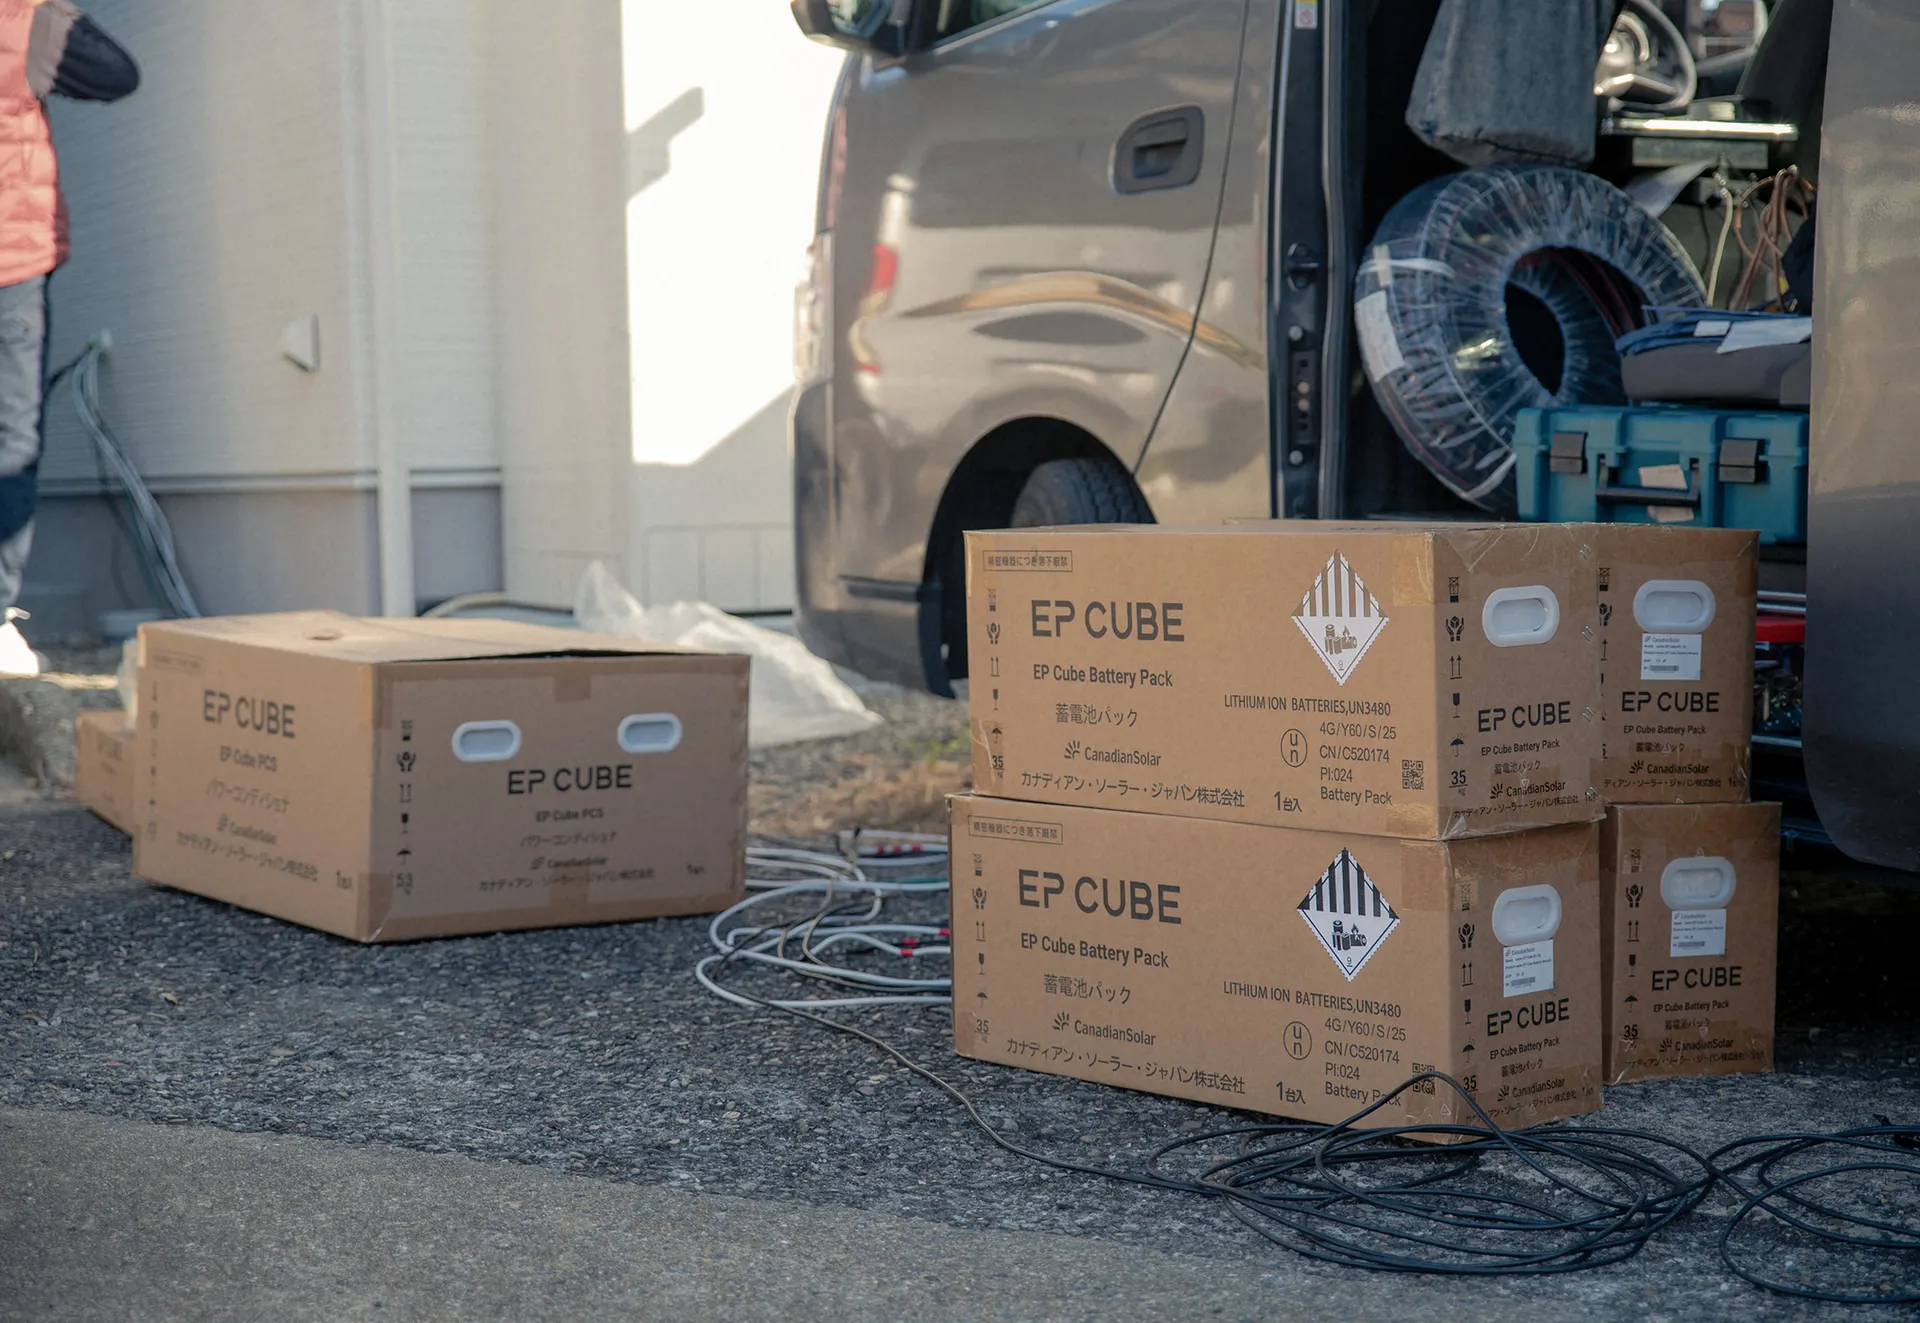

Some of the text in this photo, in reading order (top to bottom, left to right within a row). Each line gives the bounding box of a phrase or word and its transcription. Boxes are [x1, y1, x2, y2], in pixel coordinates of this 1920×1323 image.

[1031, 600, 1185, 642] EP CUBE
[1338, 660, 1344, 668] 9
[1034, 664, 1173, 689] EP Cube Battery Pack
[1224, 694, 1265, 709] LITHIUM
[1268, 697, 1287, 710] ION
[1621, 691, 1720, 712] EP CUBE
[203, 689, 296, 738] EP CUBE
[1056, 703, 1138, 727] 蓄電池パック
[1478, 701, 1571, 732] EP CUBE
[1624, 725, 1706, 736] EP Cube Battery Pack
[1085, 747, 1161, 766] CanadianSolar
[1320, 745, 1389, 762] CN/C520174
[1481, 739, 1560, 756] EP Cube Battery Pack
[220, 745, 278, 772] EP Cube PCS
[992, 755, 1003, 768] 35
[1320, 768, 1353, 782] PI:024
[1451, 770, 1466, 785] 35
[1647, 764, 1709, 774] CanadianSolar
[508, 764, 633, 795] EP CUBE
[1507, 781, 1566, 797] CanadianSolar
[1321, 787, 1392, 806] Battery Pack
[536, 808, 604, 823] EP Cube PCS
[1018, 869, 1182, 924] EP CUBE
[1021, 932, 1169, 968] EP Cube Battery Pack
[1347, 956, 1352, 965] 9
[1652, 966, 1742, 991] EP CUBE
[1044, 973, 1131, 1004] 蓄電池パック
[1224, 981, 1268, 999] LITHIUM
[1271, 987, 1290, 1002] ION
[1654, 1000, 1729, 1012] EP Cube Battery Pack
[976, 1019, 989, 1033] 35
[1487, 998, 1570, 1036] EP CUBE
[1074, 1020, 1156, 1046] CanadianSolar
[1624, 1024, 1638, 1038] 35
[1325, 1040, 1400, 1064] CN/C520174
[1490, 1037, 1560, 1060] EP Cube Battery Pack
[1676, 1039, 1734, 1050] CanadianSolar
[1325, 1062, 1360, 1080] PI:024
[1463, 1075, 1477, 1091] 35
[1512, 1078, 1565, 1098] CanadianSolar
[1325, 1082, 1369, 1105] Battery
